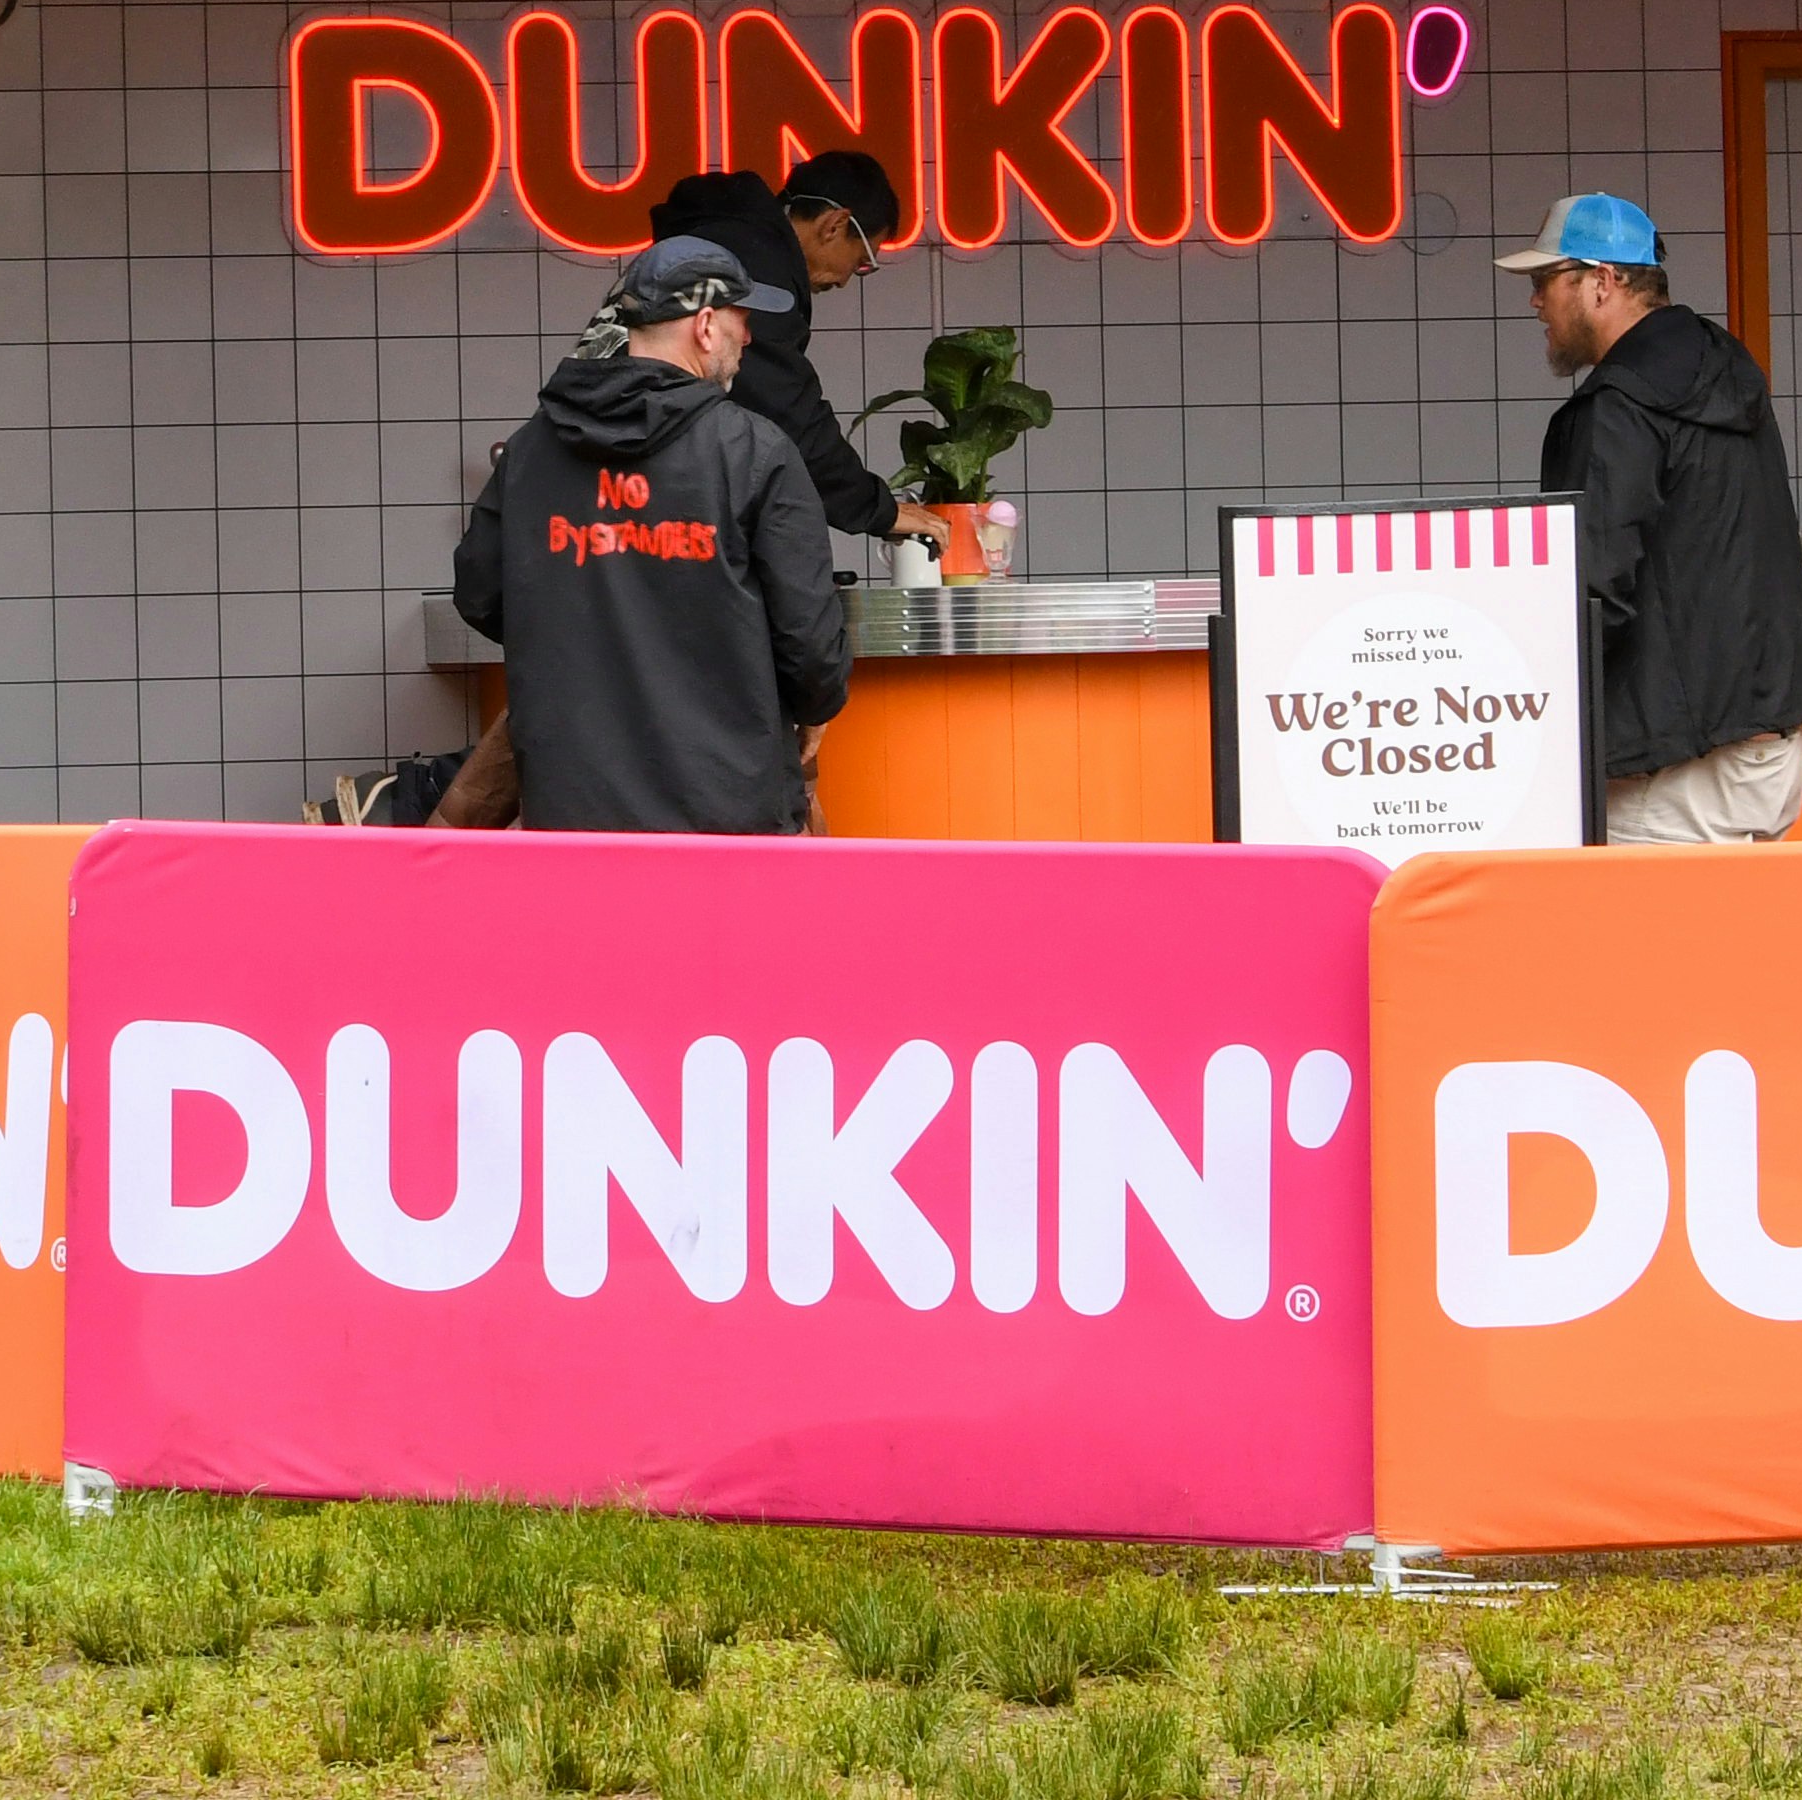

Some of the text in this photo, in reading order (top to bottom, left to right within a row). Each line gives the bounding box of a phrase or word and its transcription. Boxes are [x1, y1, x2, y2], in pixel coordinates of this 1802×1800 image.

[290, 3, 1469, 256] DUNKIN'
[597, 467, 650, 510] NO
[1351, 647, 1416, 664] missed
[1364, 627, 1449, 644] Sorry we
[1265, 686, 1551, 733] We're Now
[1321, 732, 1497, 778] Closed
[1337, 819, 1485, 838] back tomorrow
[1373, 799, 1448, 816] We'll be
[109, 1019, 1354, 1321] DUNKIN'
